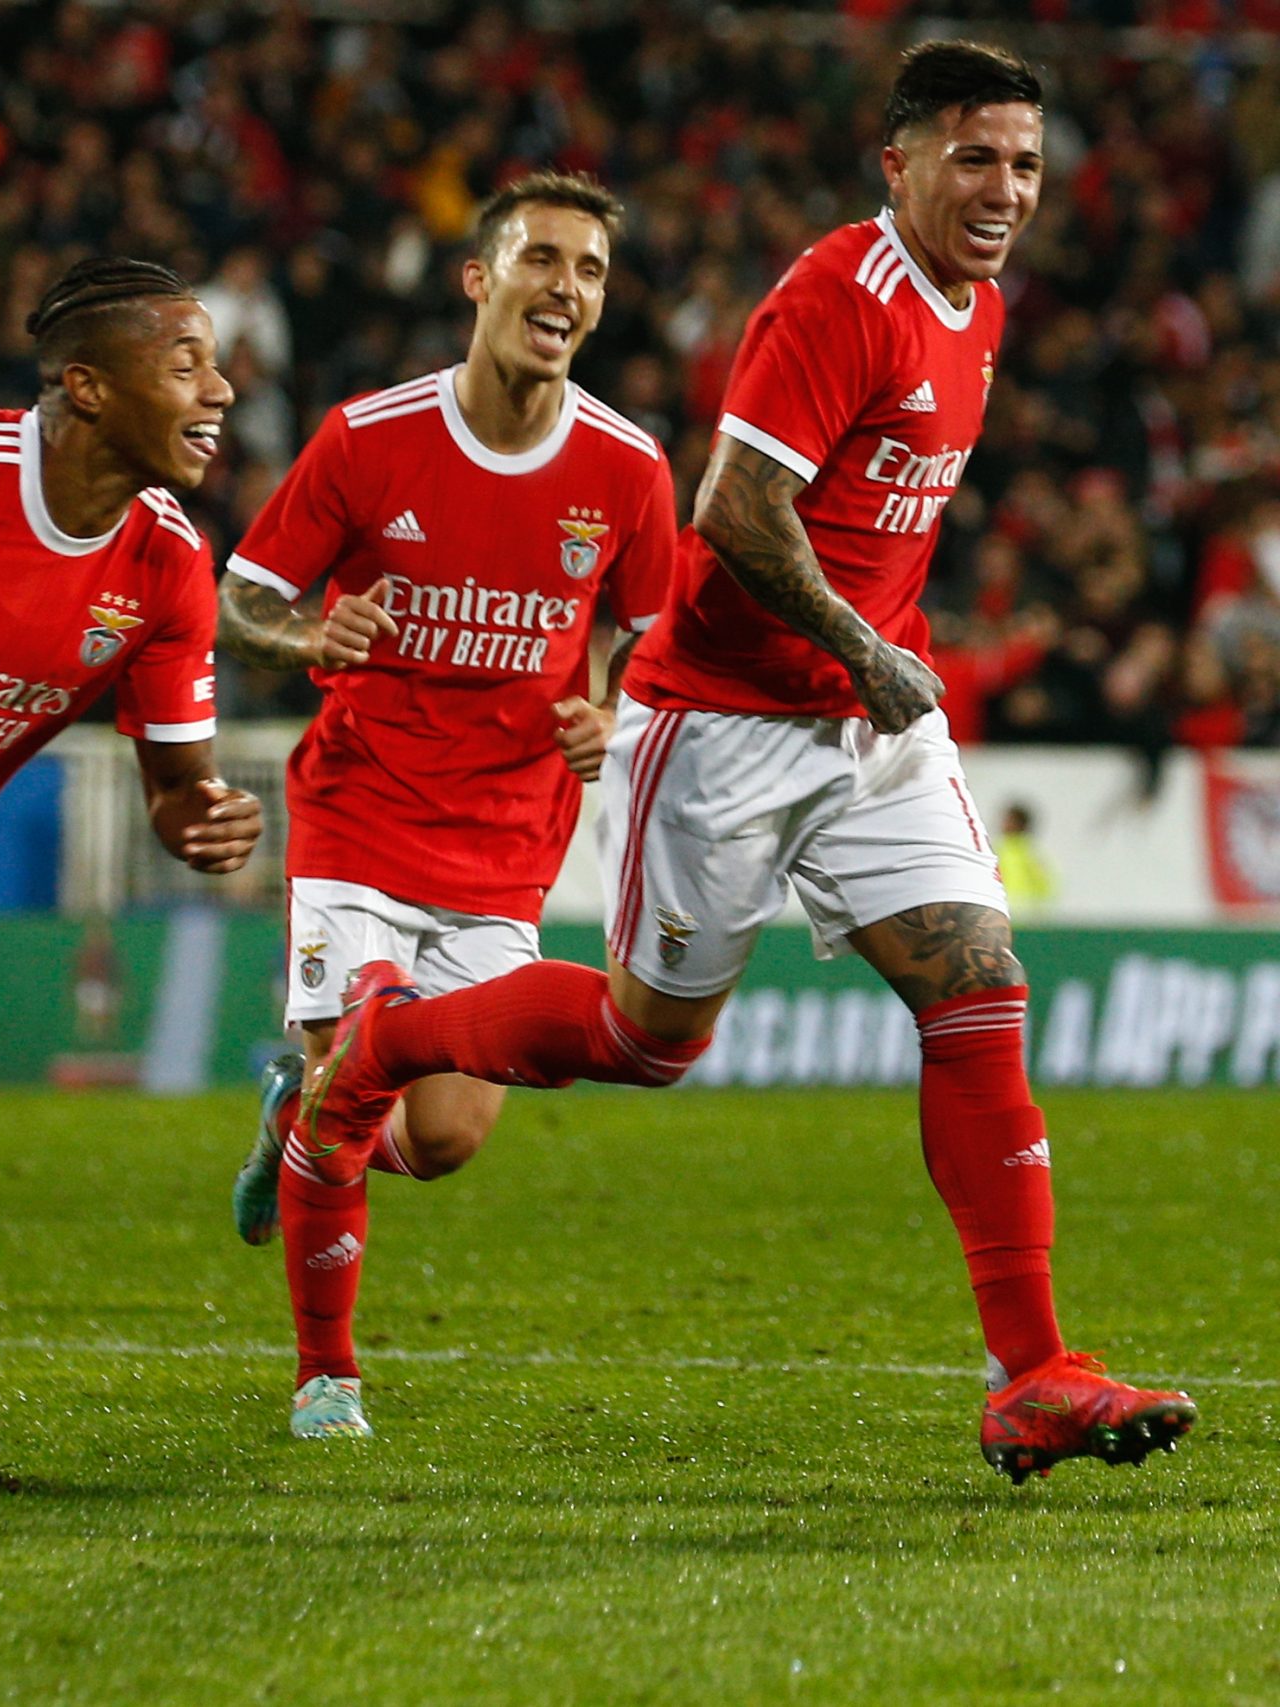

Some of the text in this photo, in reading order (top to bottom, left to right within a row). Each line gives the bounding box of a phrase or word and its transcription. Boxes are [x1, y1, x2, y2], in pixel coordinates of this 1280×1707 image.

[382, 572, 580, 631] Emirates
[398, 622, 548, 673] FLY BETTER
